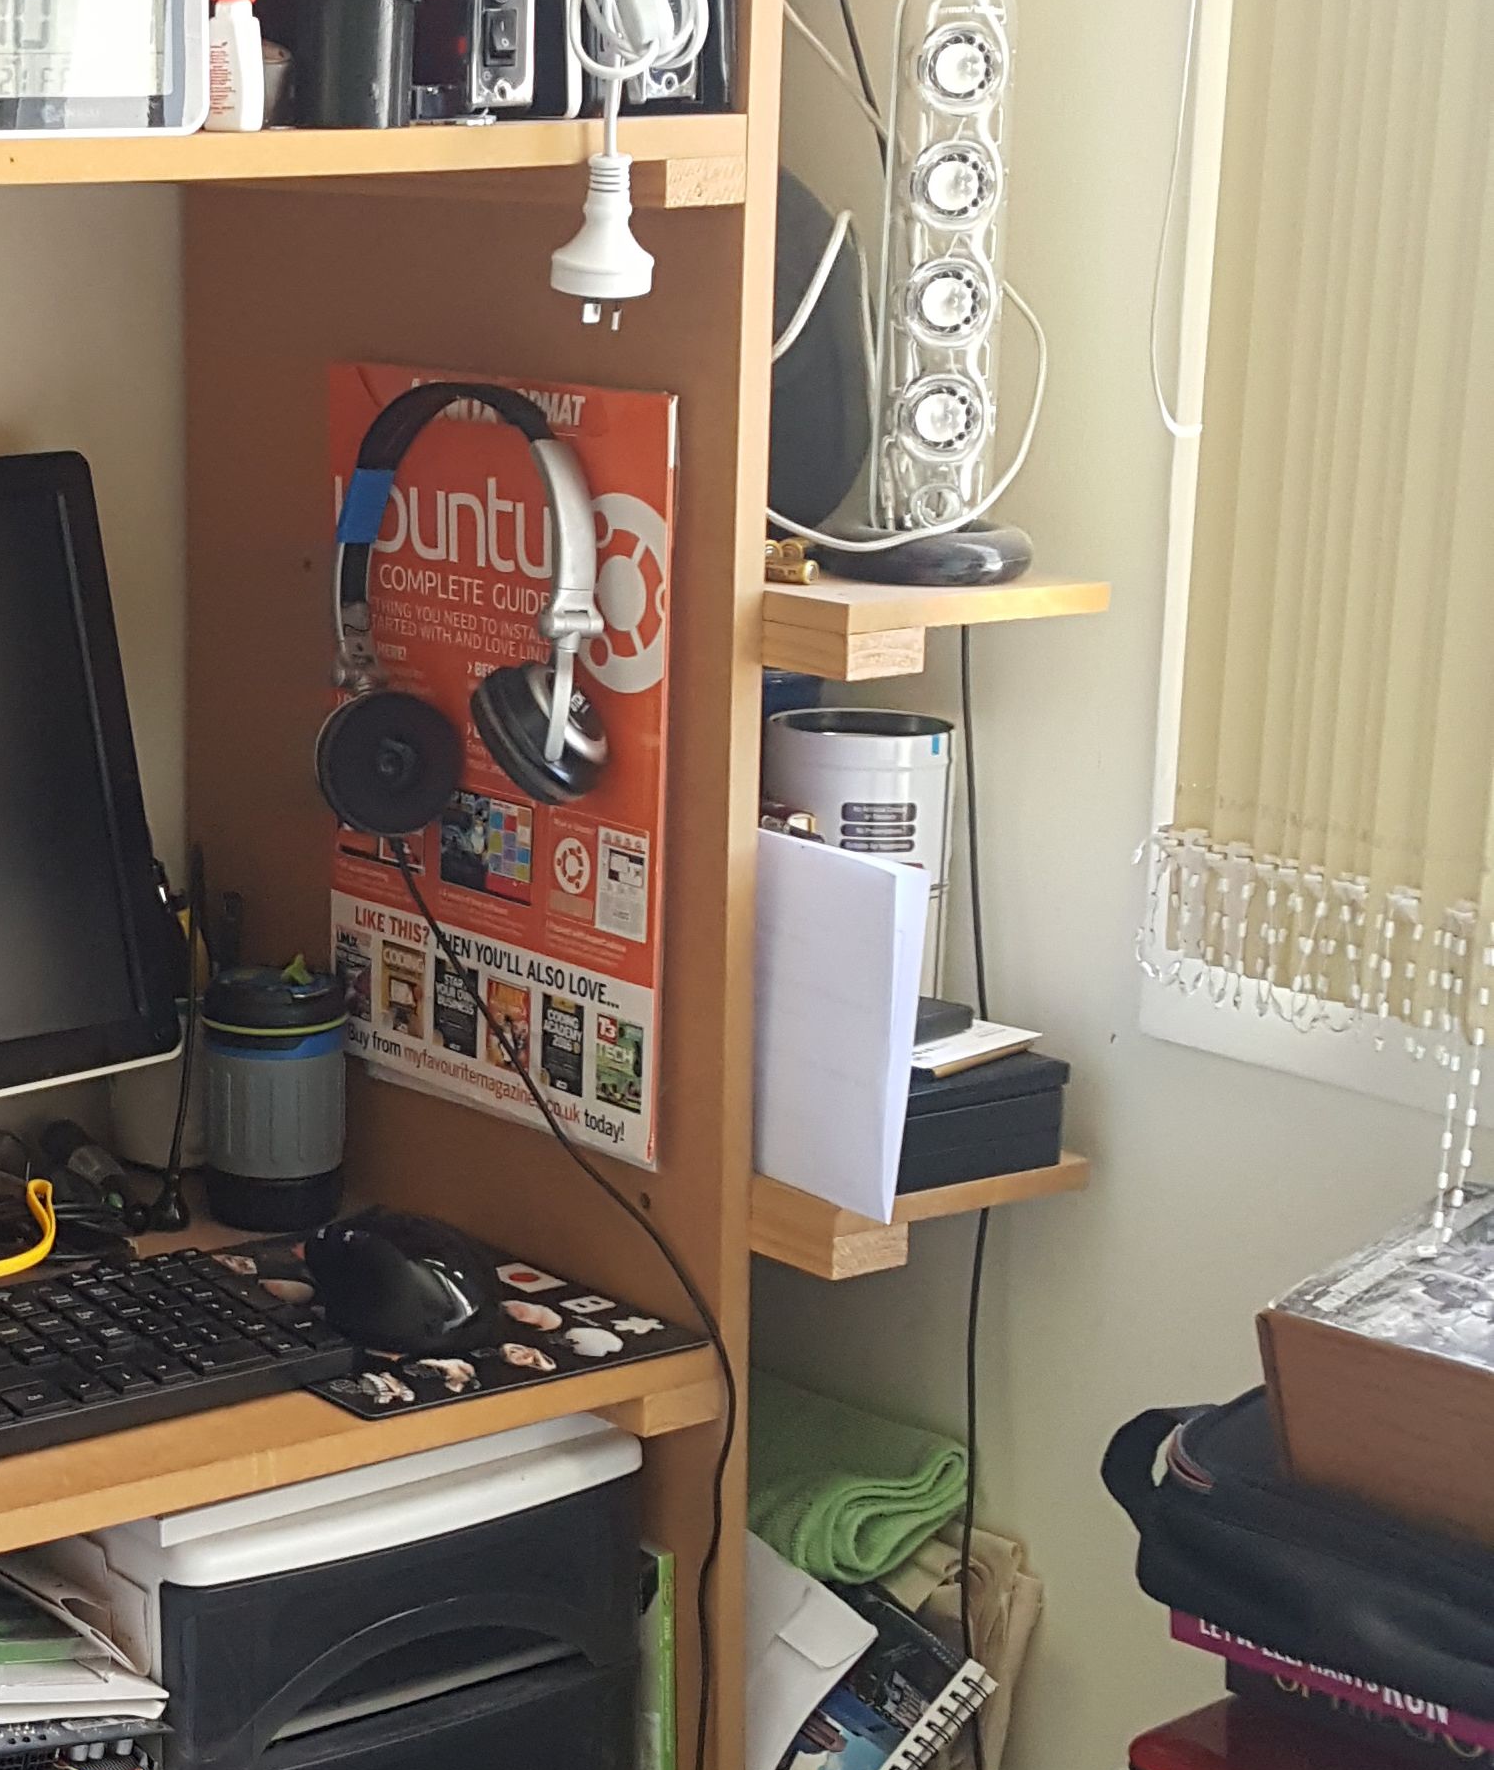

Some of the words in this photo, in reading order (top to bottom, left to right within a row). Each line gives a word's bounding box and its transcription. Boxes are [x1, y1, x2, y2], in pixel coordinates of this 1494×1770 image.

[379, 565, 484, 605] COMPLETE
[415, 605, 442, 625] YOU
[444, 610, 477, 632] NEED
[480, 616, 497, 635] TO
[421, 624, 452, 644] WITH
[456, 630, 482, 650] AND
[485, 636, 517, 658] LOVE
[354, 904, 385, 935] LIKE
[388, 916, 430, 946] THIS?
[474, 940, 524, 977] YOU'LL
[527, 955, 565, 990] ALSO
[373, 1030, 402, 1059] from
[584, 1108, 625, 1143] today!
